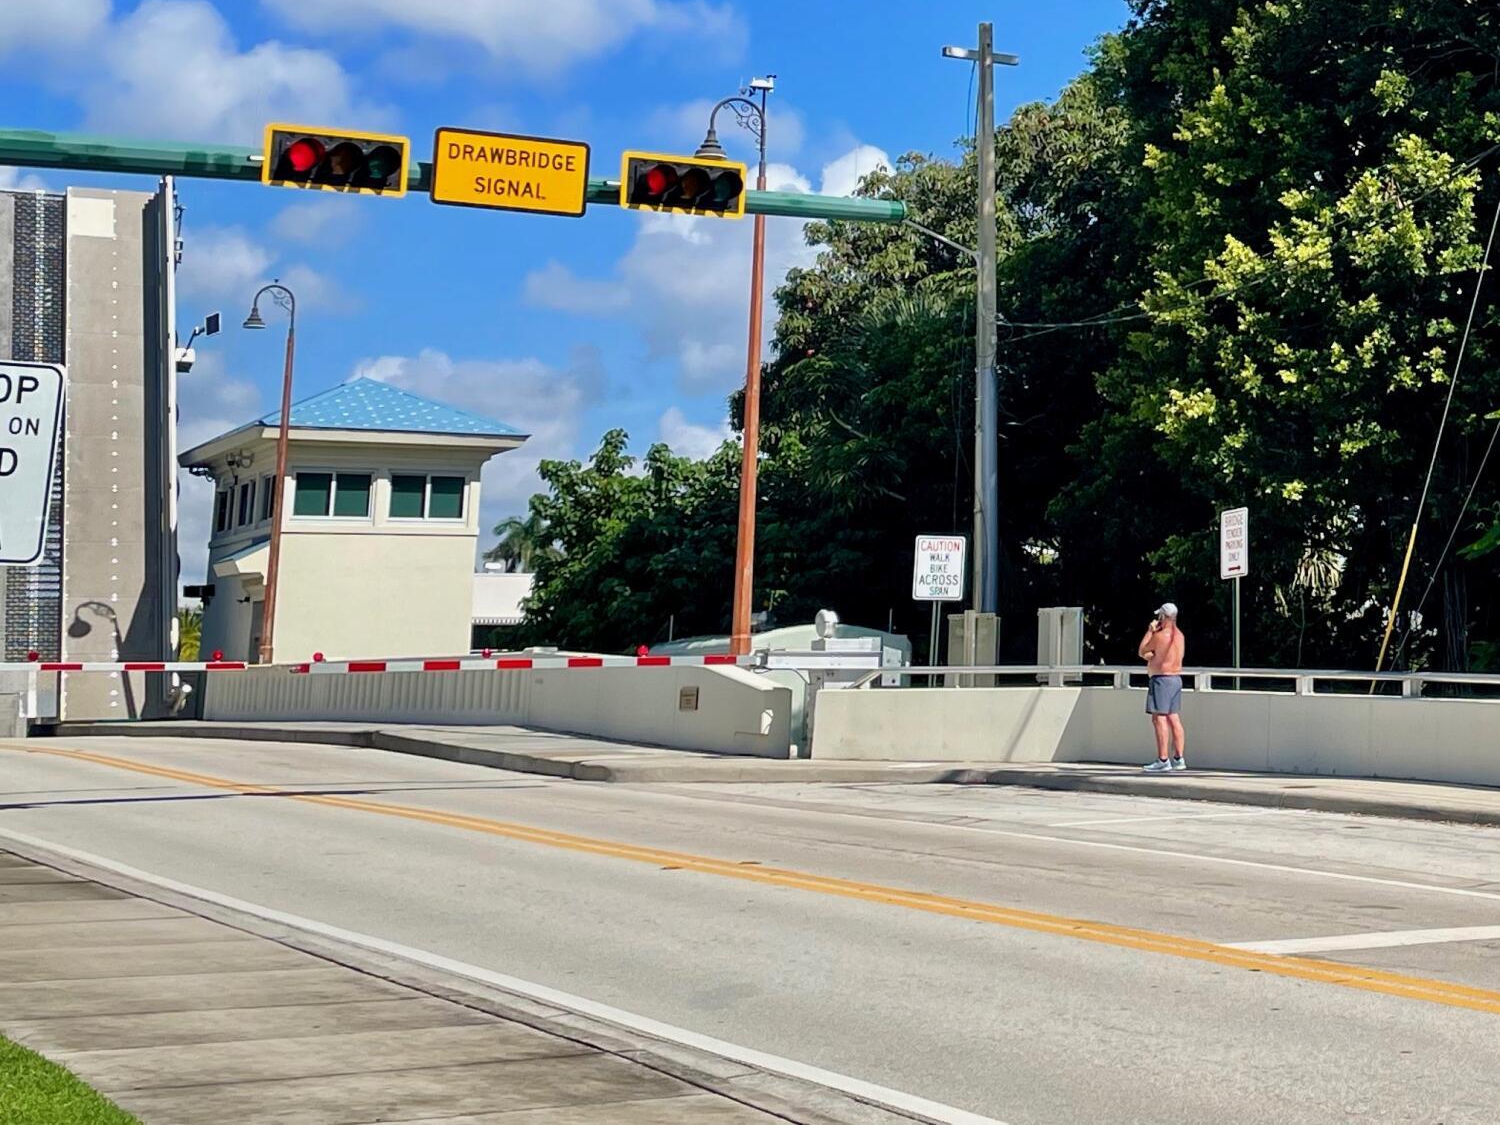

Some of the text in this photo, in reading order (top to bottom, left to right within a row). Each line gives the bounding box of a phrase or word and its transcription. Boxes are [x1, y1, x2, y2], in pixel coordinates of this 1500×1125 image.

[448, 143, 576, 172] DRAWBRIDGE
[474, 177, 546, 200] SIGNAL
[0, 374, 39, 404] OP
[9, 417, 40, 436] ON
[921, 540, 961, 552] CAUTION
[929, 553, 950, 562] WALK
[930, 564, 949, 573] BIKE
[919, 574, 959, 585] ACROSS
[929, 587, 949, 596] SPAN
